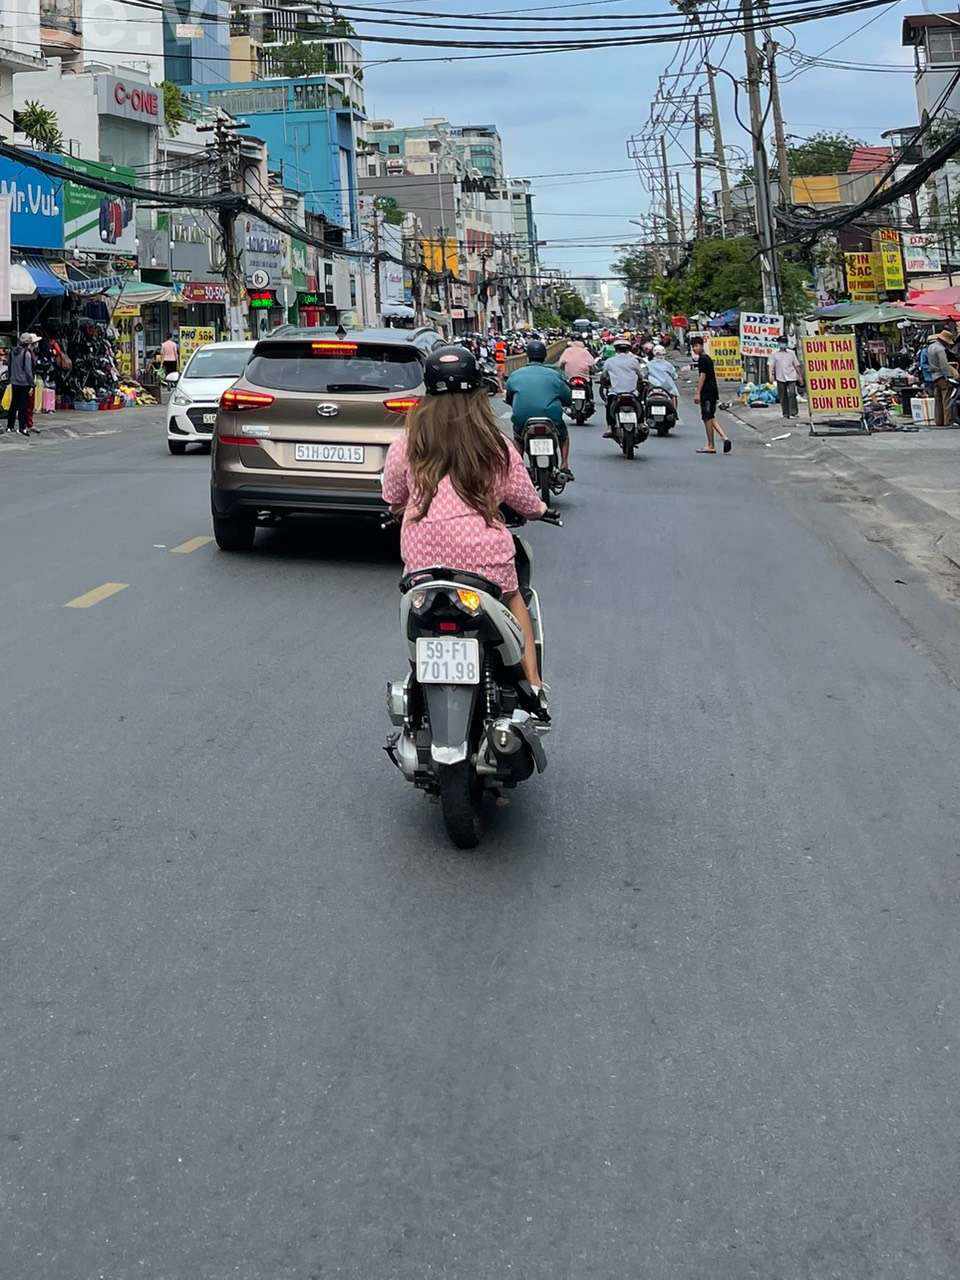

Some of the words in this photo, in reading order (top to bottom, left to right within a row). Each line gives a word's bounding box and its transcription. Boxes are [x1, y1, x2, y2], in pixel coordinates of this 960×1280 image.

[114, 81, 159, 116] C-ONE
[806, 339, 826, 353] BÚN
[808, 357, 827, 372] BÚN
[810, 376, 836, 391] BÚN
[812, 395, 833, 409] BÚN
[426, 642, 468, 661] 59-F1
[421, 661, 475, 680] 701.98
